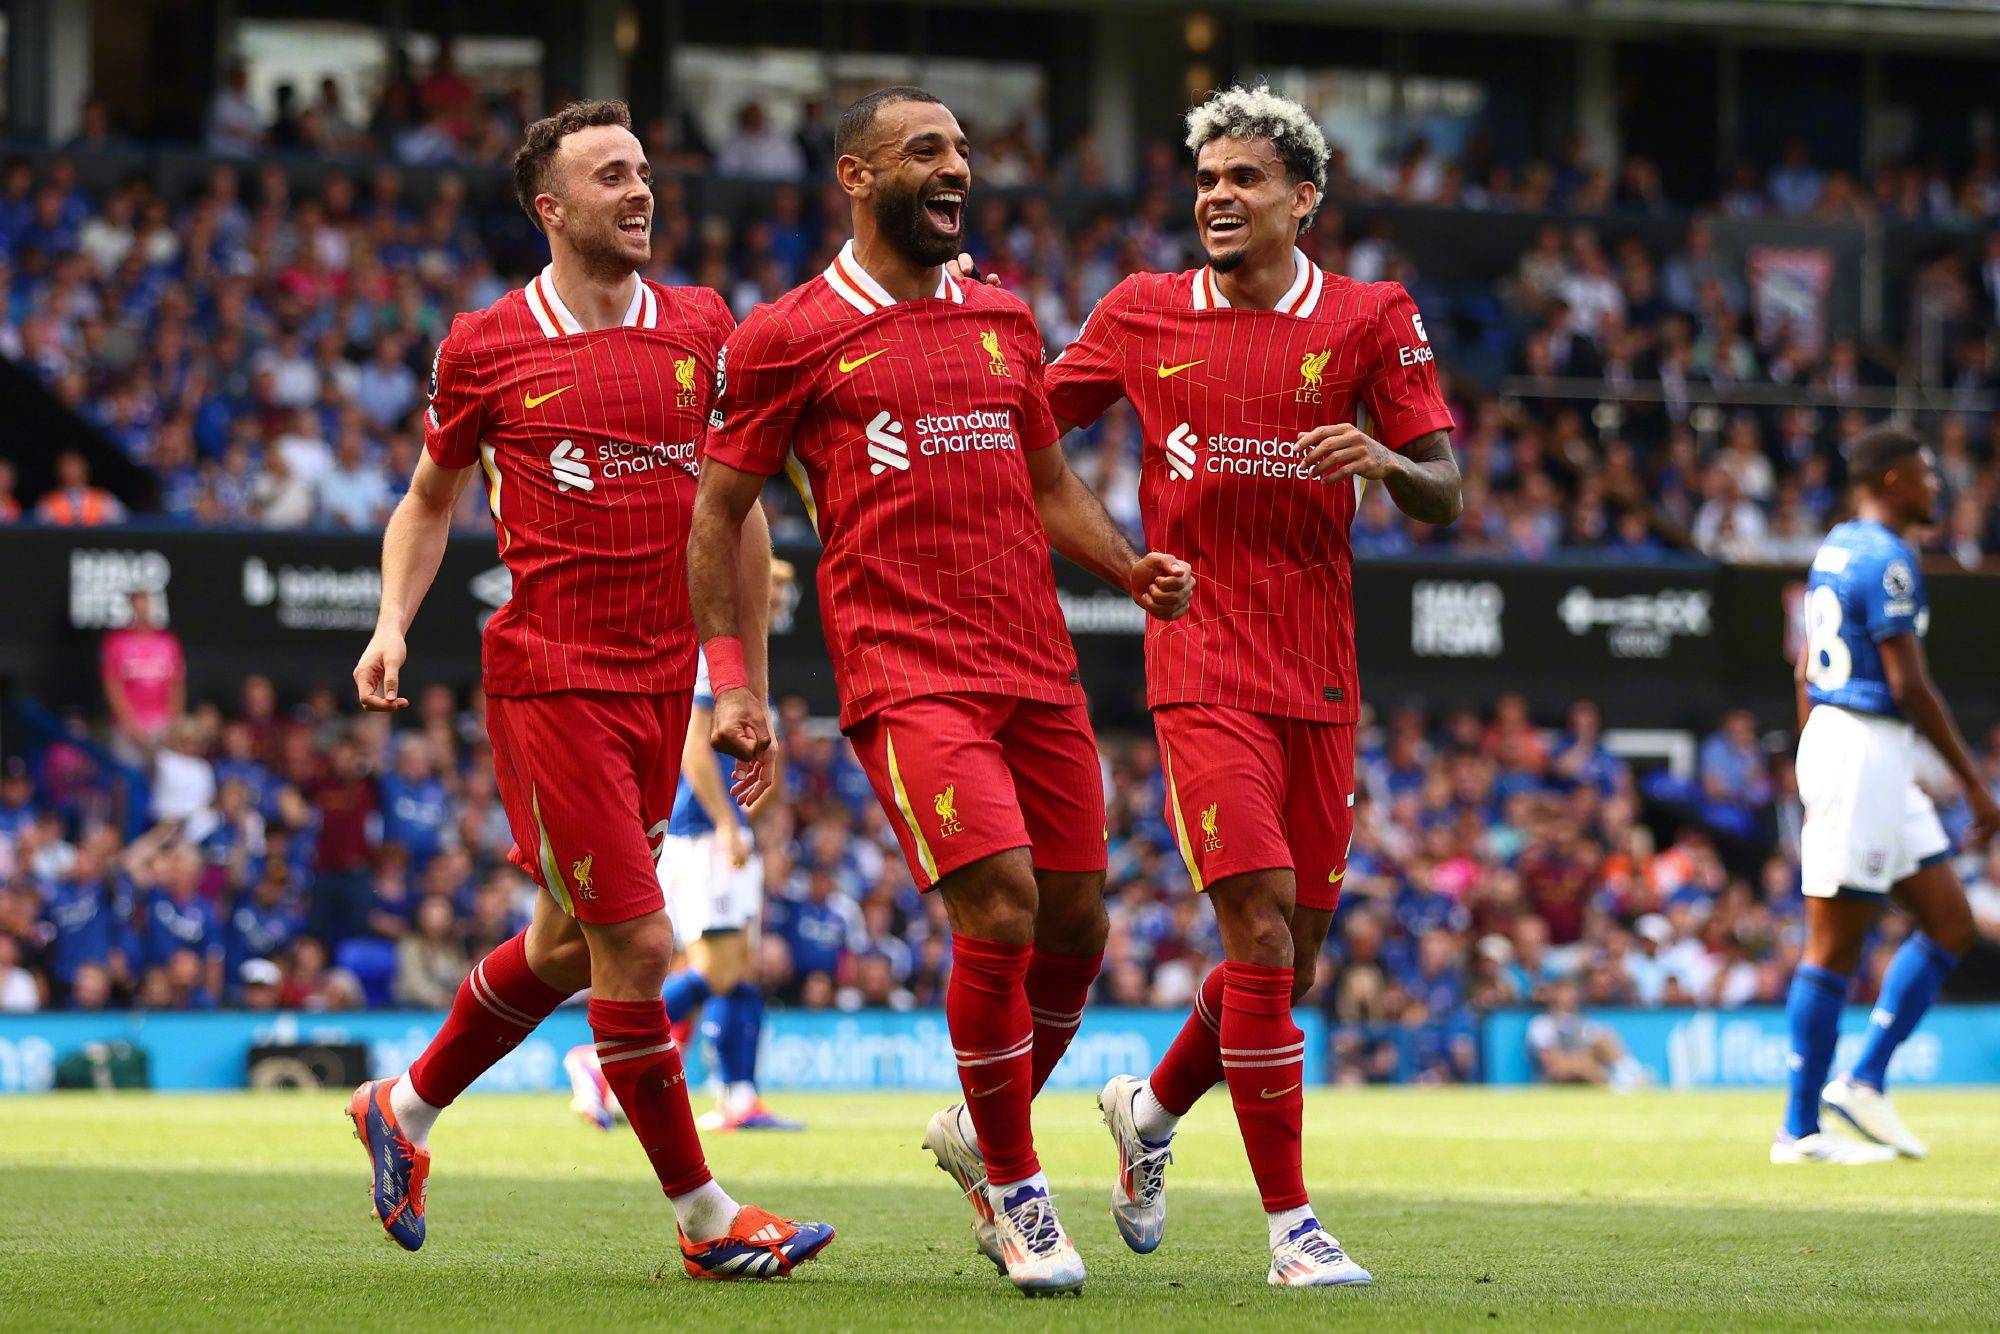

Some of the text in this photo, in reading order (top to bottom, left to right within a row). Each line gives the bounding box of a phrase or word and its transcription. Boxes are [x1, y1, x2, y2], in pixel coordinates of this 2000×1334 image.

[915, 409, 1010, 435] standard
[920, 430, 1016, 456] chartered
[1207, 433, 1316, 459] standa
[1804, 584, 1852, 691] 8
